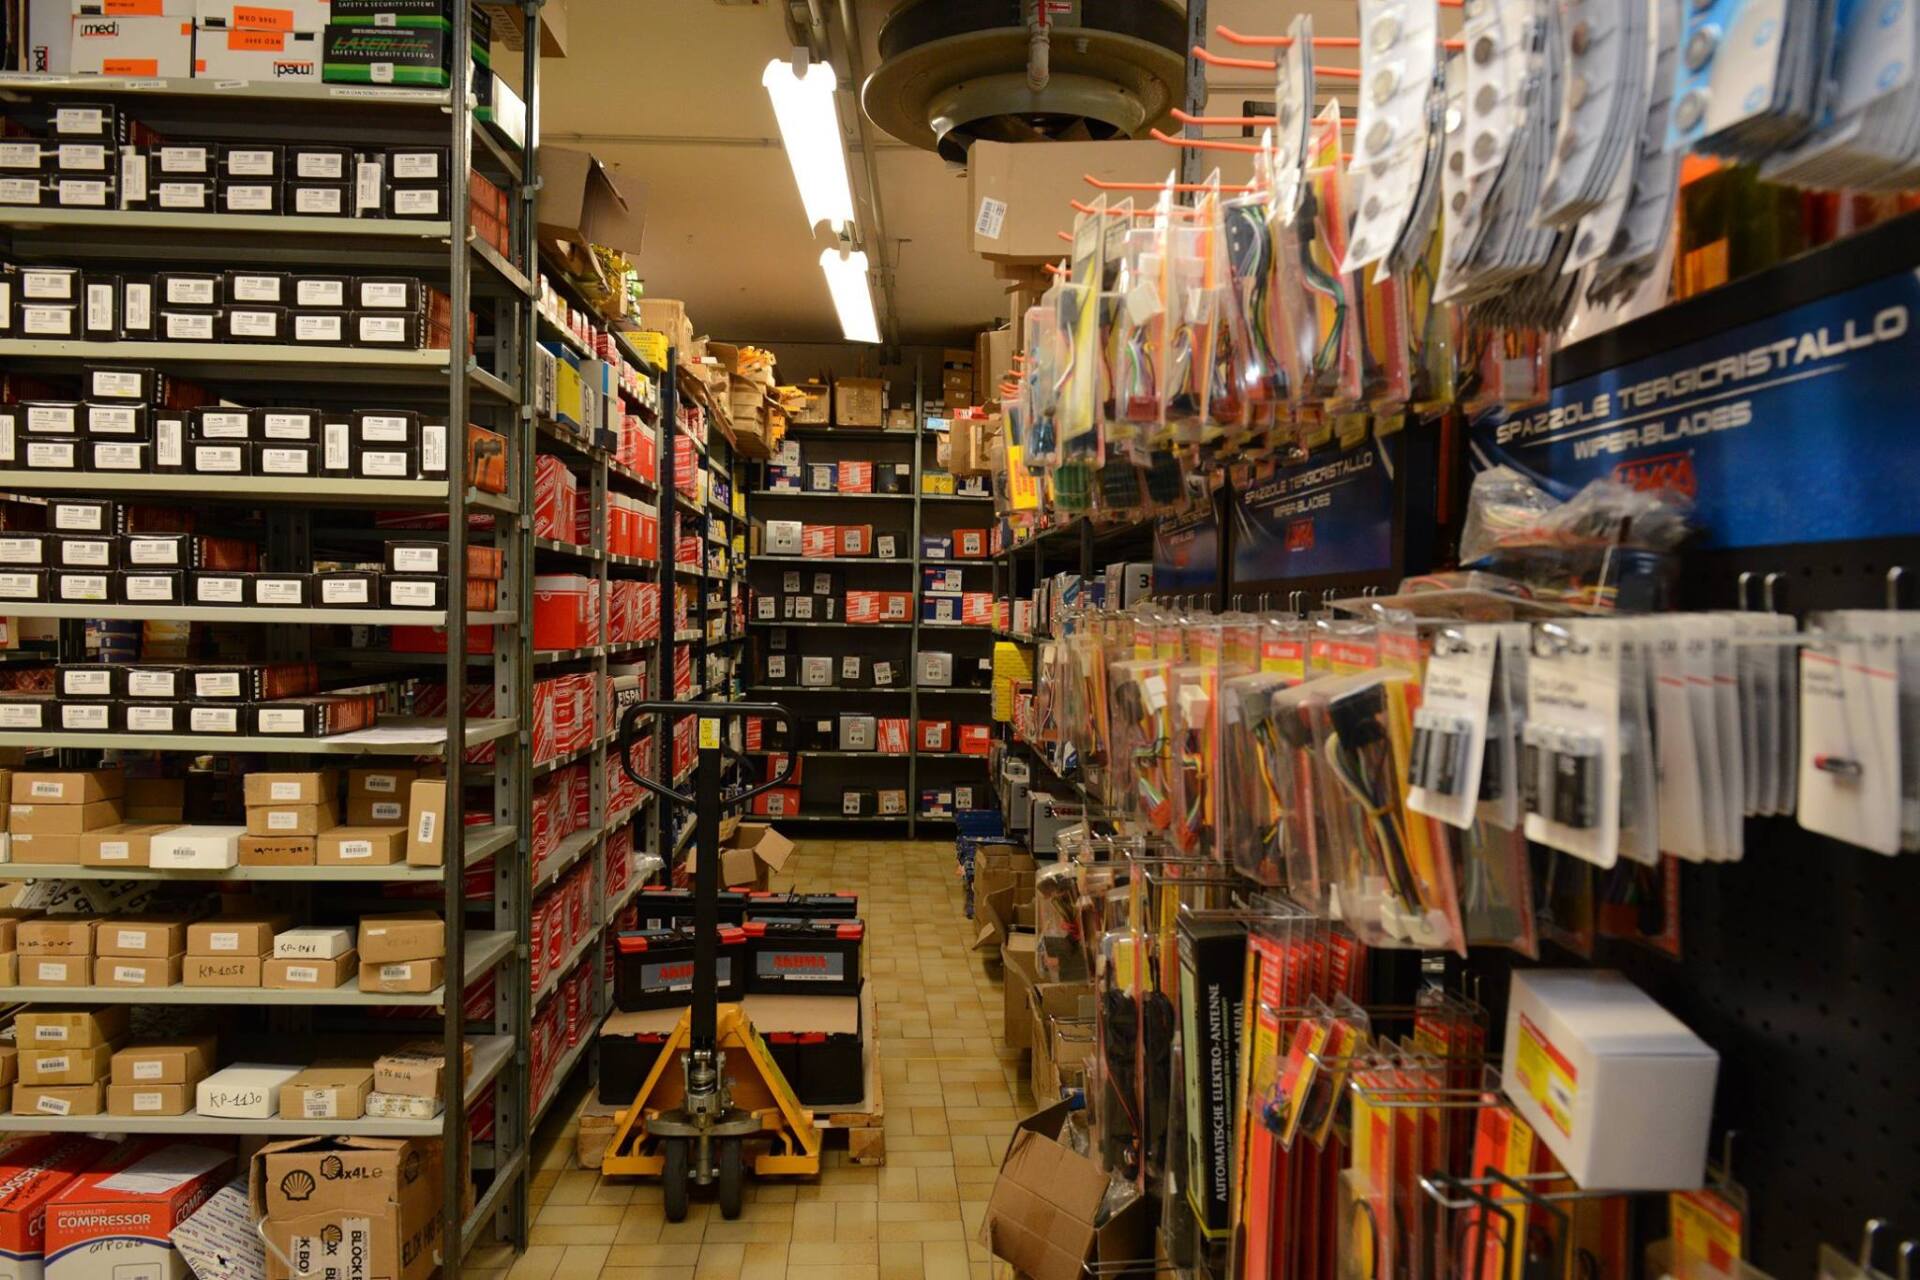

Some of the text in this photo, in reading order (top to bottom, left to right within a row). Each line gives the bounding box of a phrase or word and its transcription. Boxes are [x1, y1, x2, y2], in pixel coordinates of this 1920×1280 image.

[331, 49, 358, 57] SAFETY
[366, 50, 400, 58] SECURITY
[402, 51, 435, 59] SYSTEMS
[1495, 304, 1909, 445] SPAZZOLE TERGICRISTALLO
[1244, 451, 1374, 505] SPAZZOLE TERGICRISTALLO
[1208, 983, 1224, 1100] ELEKTRO-ANTENNE
[209, 1093, 263, 1108] KP-1130
[1211, 1103, 1227, 1201] AUTOMATISCHE
[58, 1213, 151, 1229] COMPRESSOR
[351, 1230, 362, 1274] BLOCK
